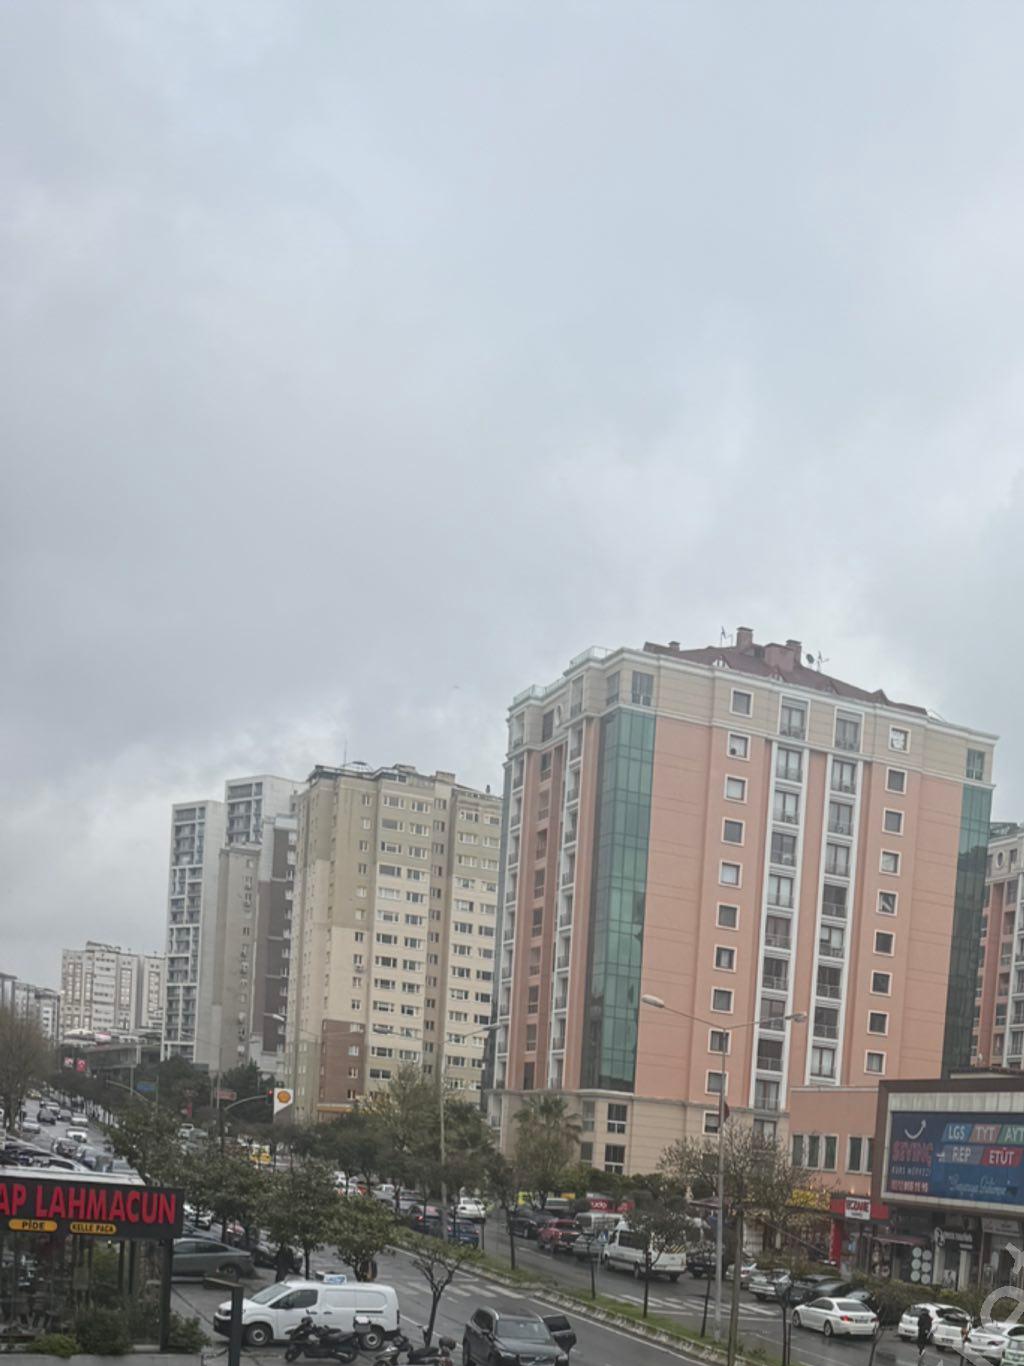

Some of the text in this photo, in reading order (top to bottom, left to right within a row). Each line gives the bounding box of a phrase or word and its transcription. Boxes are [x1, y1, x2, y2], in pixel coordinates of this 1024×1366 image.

[948, 1125, 965, 1140] LGS
[975, 1127, 995, 1142] TYT
[989, 1147, 1015, 1165] ETÜT
[36, 1184, 177, 1225] LAHMACUN
